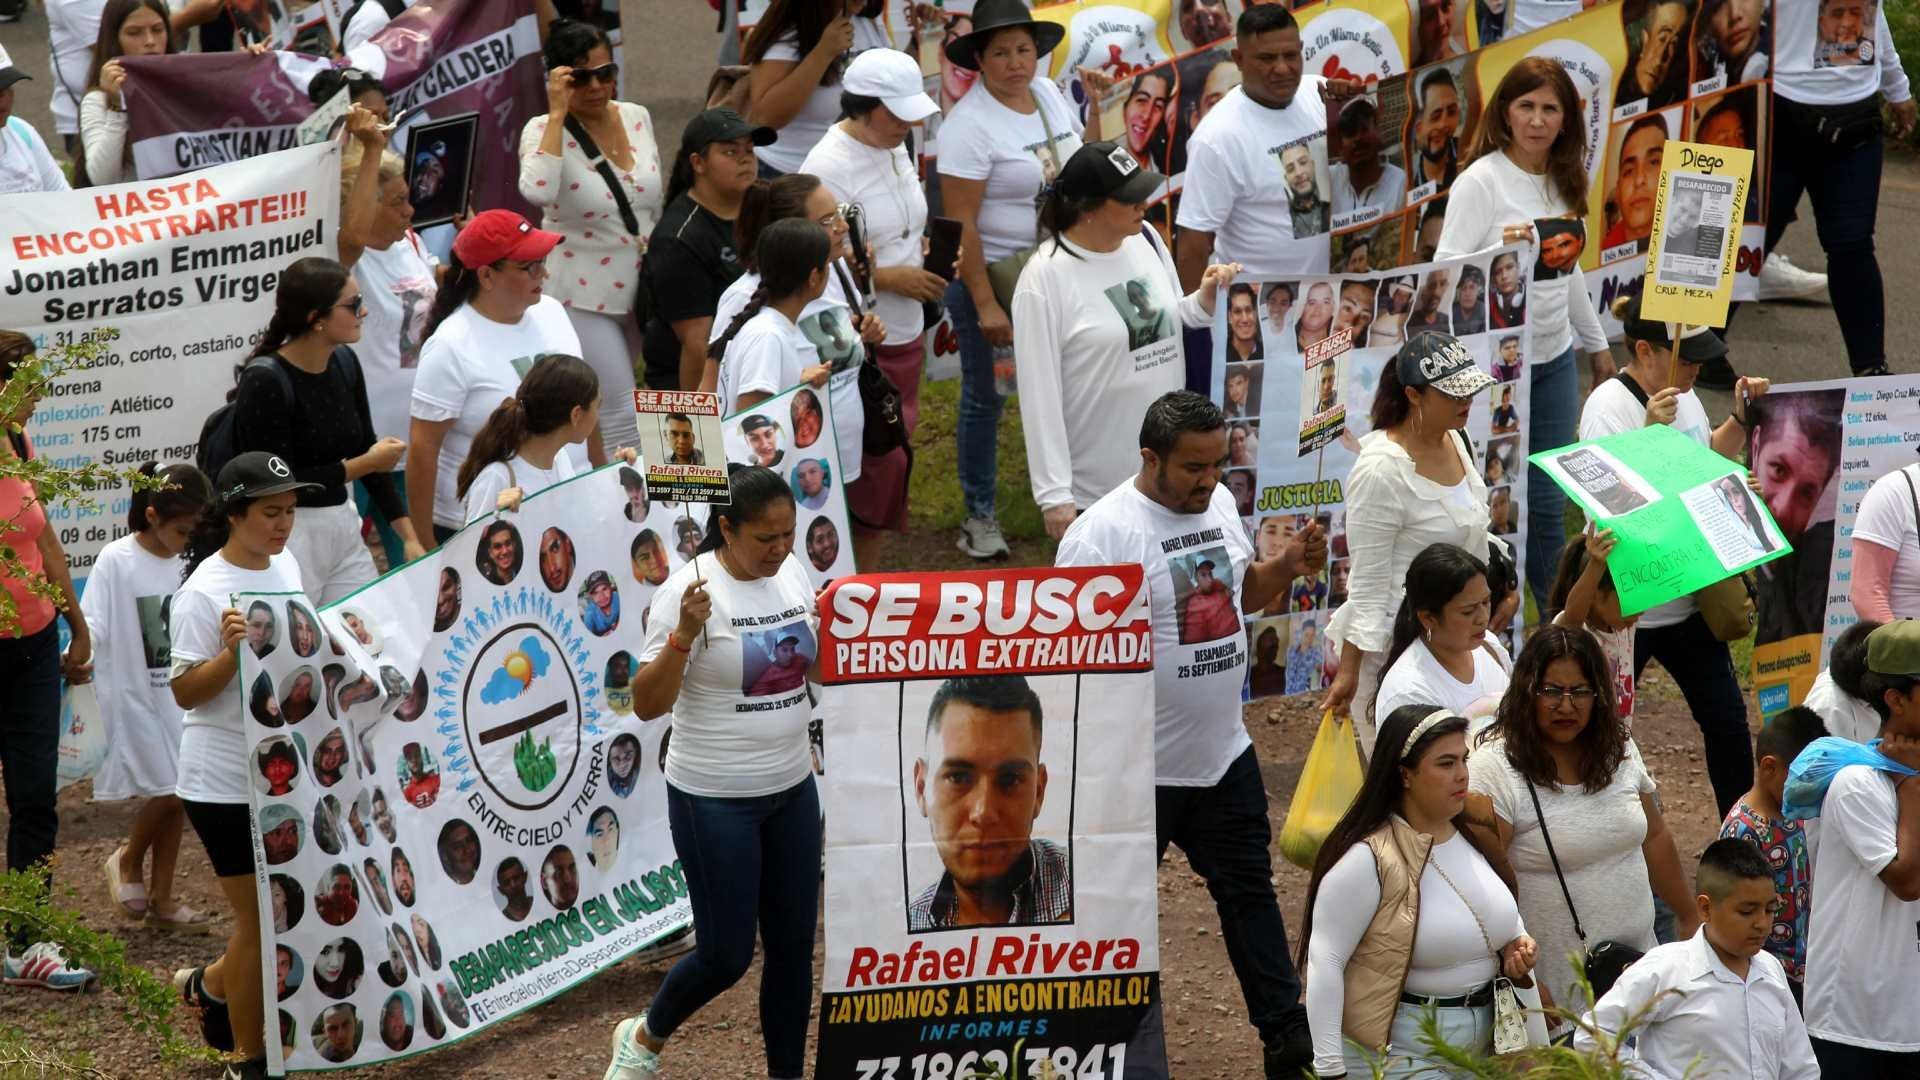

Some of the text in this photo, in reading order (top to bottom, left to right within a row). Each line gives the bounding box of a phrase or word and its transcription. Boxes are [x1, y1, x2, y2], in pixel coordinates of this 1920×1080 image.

[422, 31, 517, 100] CALDERA
[175, 129, 273, 169] CHRISTIAN
[1680, 148, 1724, 175] Diego
[95, 178, 220, 221] HASTA
[1677, 179, 1728, 193] DESAPARECIDO
[13, 190, 309, 260] ENCONTRARTE!!!
[5, 219, 323, 296] Jonathan Emmanuel
[43, 285, 184, 323] Serratos
[55, 331, 73, 347] 31
[130, 346, 177, 362] corto,
[182, 333, 244, 356] castaño
[110, 395, 174, 416] Atlético
[637, 391, 716, 408] SE BUSCA
[640, 404, 715, 414] PERSONA EXTRAVIADA
[81, 427, 110, 445] 175
[115, 424, 141, 440] cm
[103, 447, 158, 466] Suéter
[163, 443, 200, 460] negr
[650, 465, 722, 477] Rafael Rivera
[1257, 479, 1344, 511] JUSTICIA
[61, 527, 79, 545] 09
[86, 525, 107, 542] de
[1161, 527, 1224, 554] RAFAEL RIVERA MORALES
[731, 616, 758, 627] RAFAEL
[759, 614, 781, 624] RIVERA
[829, 575, 1153, 640] SE BUSCA
[836, 631, 1152, 675] PERSONA EXTRAVIADA
[1194, 641, 1237, 663] DESAPARECIDO
[1178, 666, 1190, 679] 25
[1191, 656, 1234, 678] SEPTIEMBRE
[467, 741, 605, 847] ENTRE CIELO Y TIERRA
[449, 858, 690, 999] DESAPARECIDOS EN JALISCO
[846, 932, 1140, 988] Rafael Rivera
[828, 975, 1151, 1024] ¡AYUDANOS A ENCONTRARLO!
[919, 1018, 1048, 1041] INFORMES
